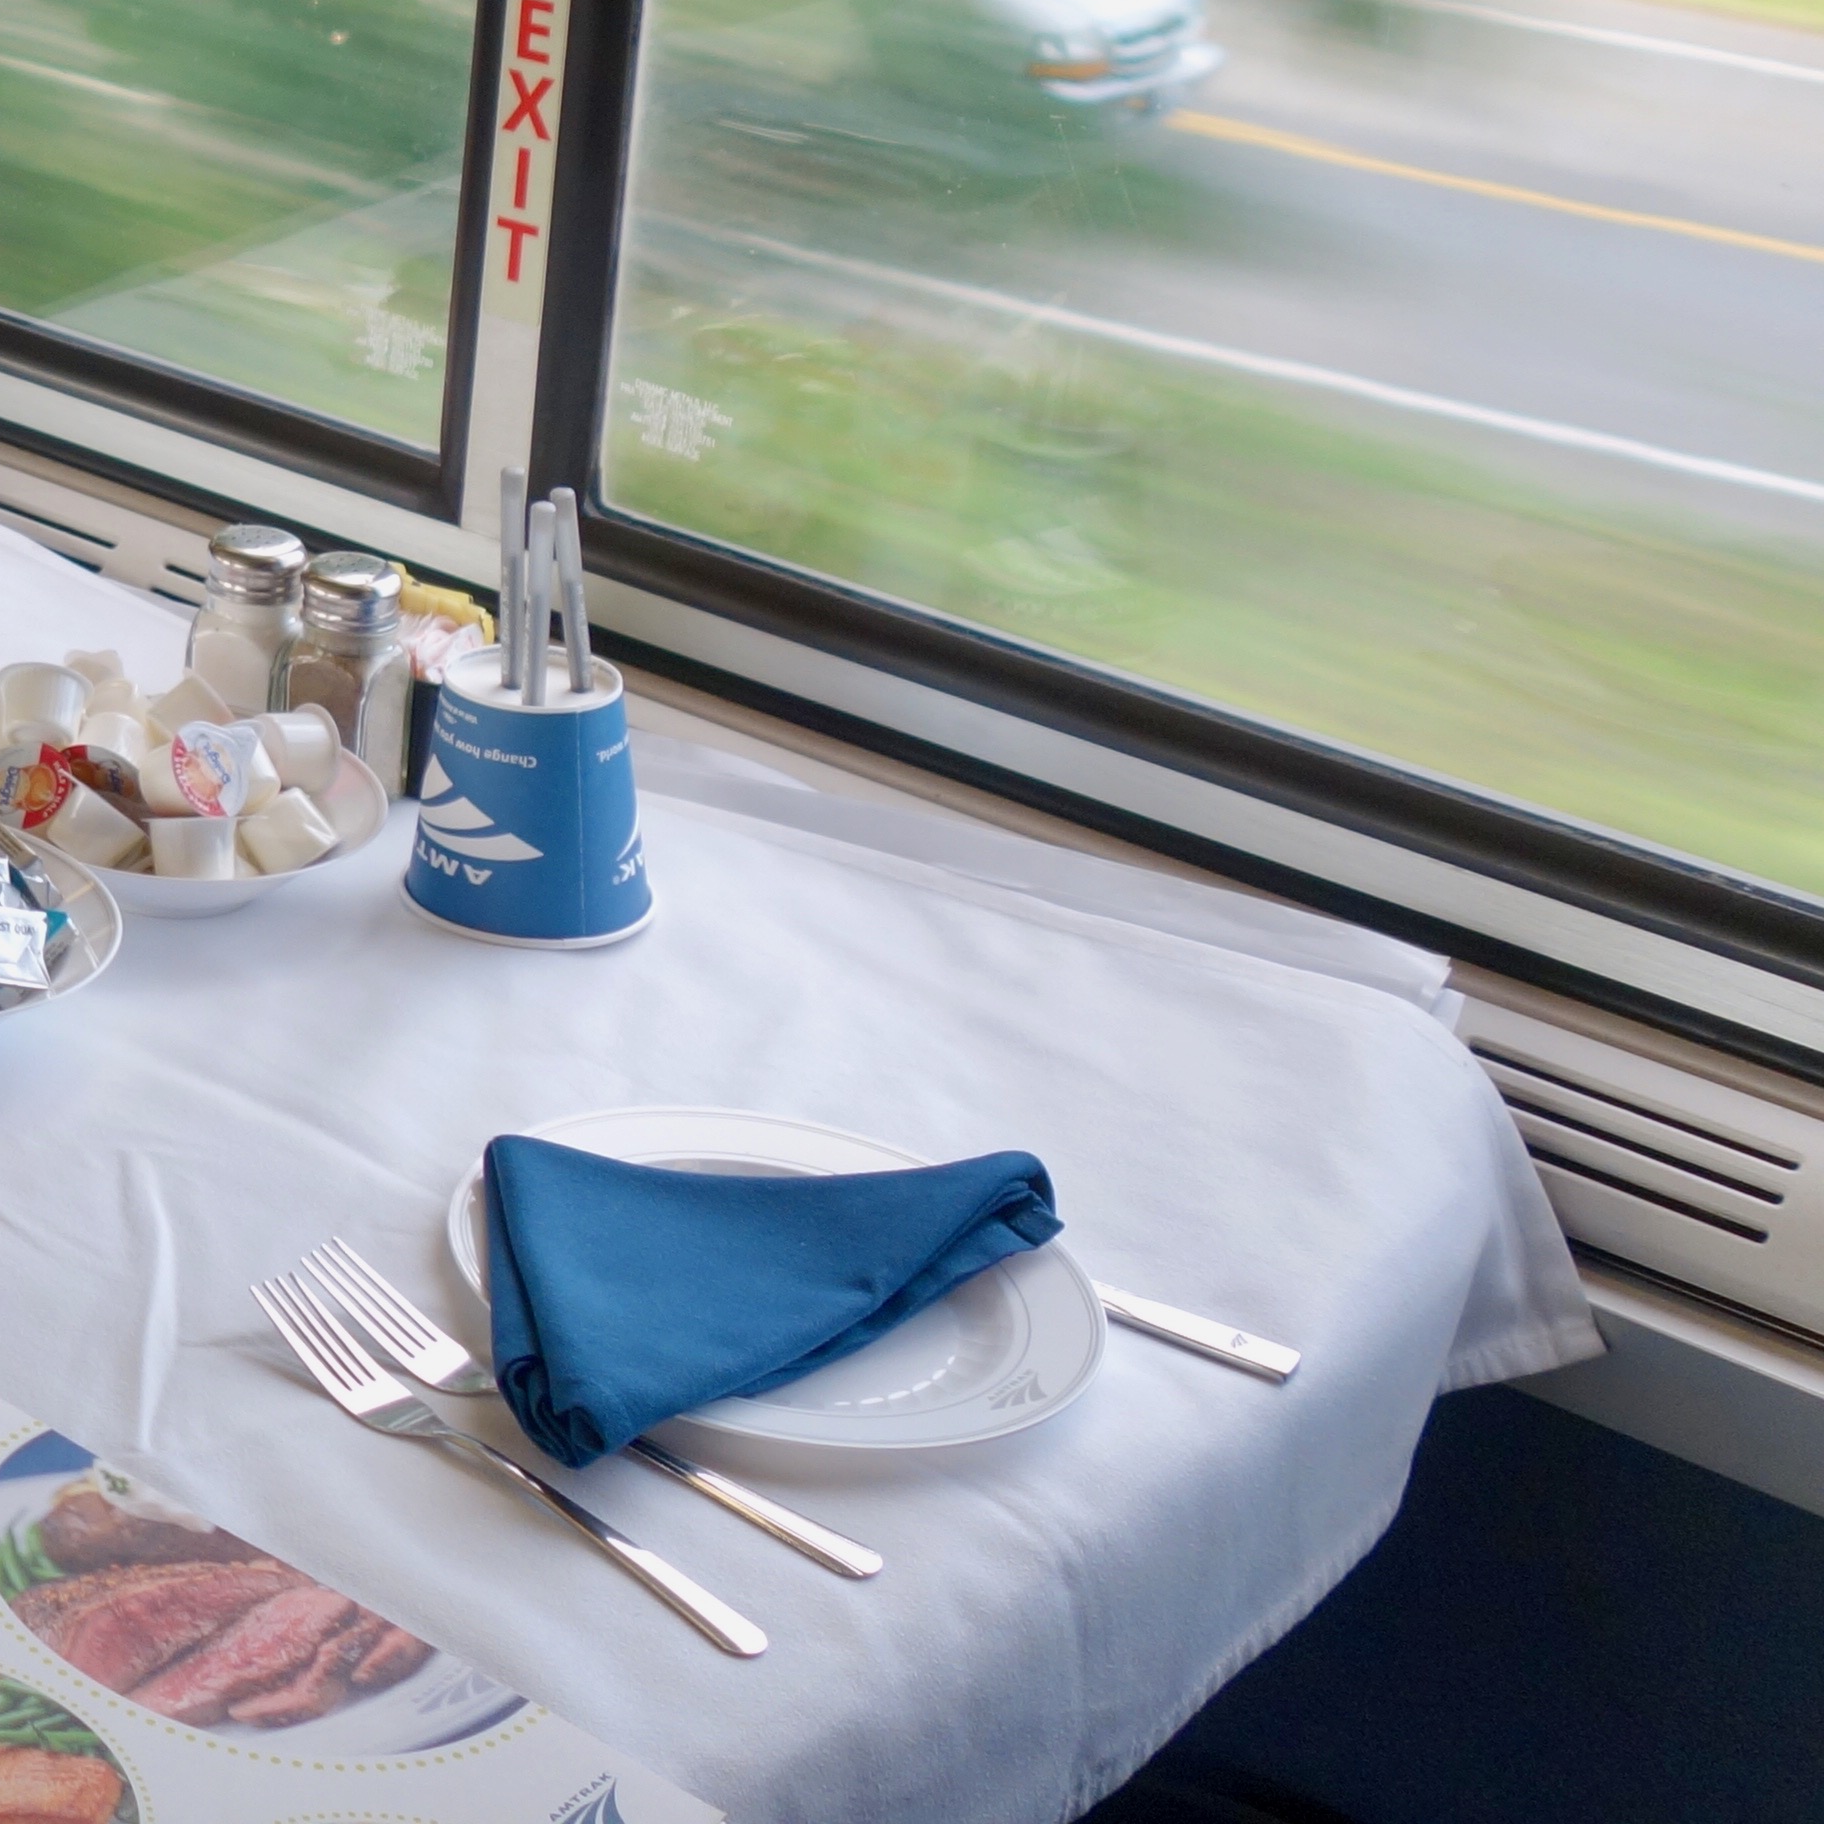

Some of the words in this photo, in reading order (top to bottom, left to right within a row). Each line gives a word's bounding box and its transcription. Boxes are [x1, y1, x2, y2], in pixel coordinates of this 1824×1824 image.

[455, 739, 480, 759] how
[484, 749, 537, 768] Change
[416, 841, 493, 886] AMT
[548, 1771, 612, 1823] AMTRAK
